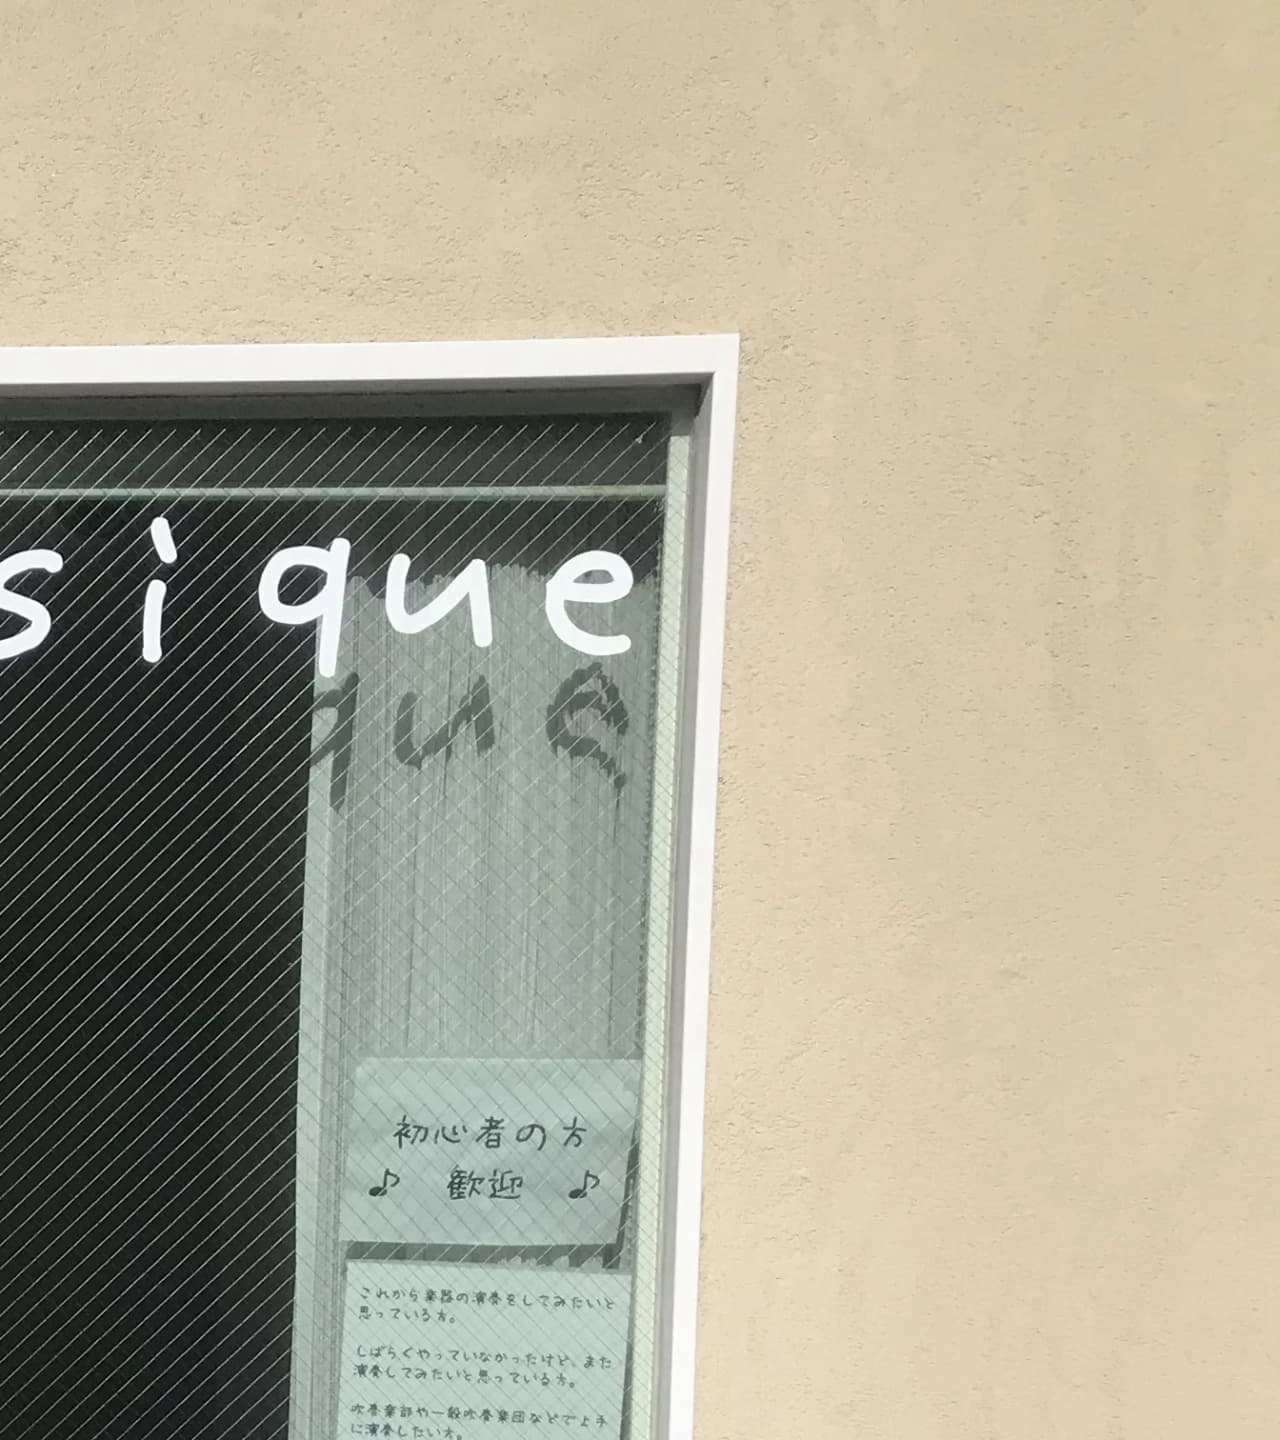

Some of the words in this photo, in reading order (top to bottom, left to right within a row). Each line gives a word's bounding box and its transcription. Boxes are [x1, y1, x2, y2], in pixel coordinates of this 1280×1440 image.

[393, 1114, 587, 1150] 初心者の方
[446, 1165, 523, 1200] 歓迎
